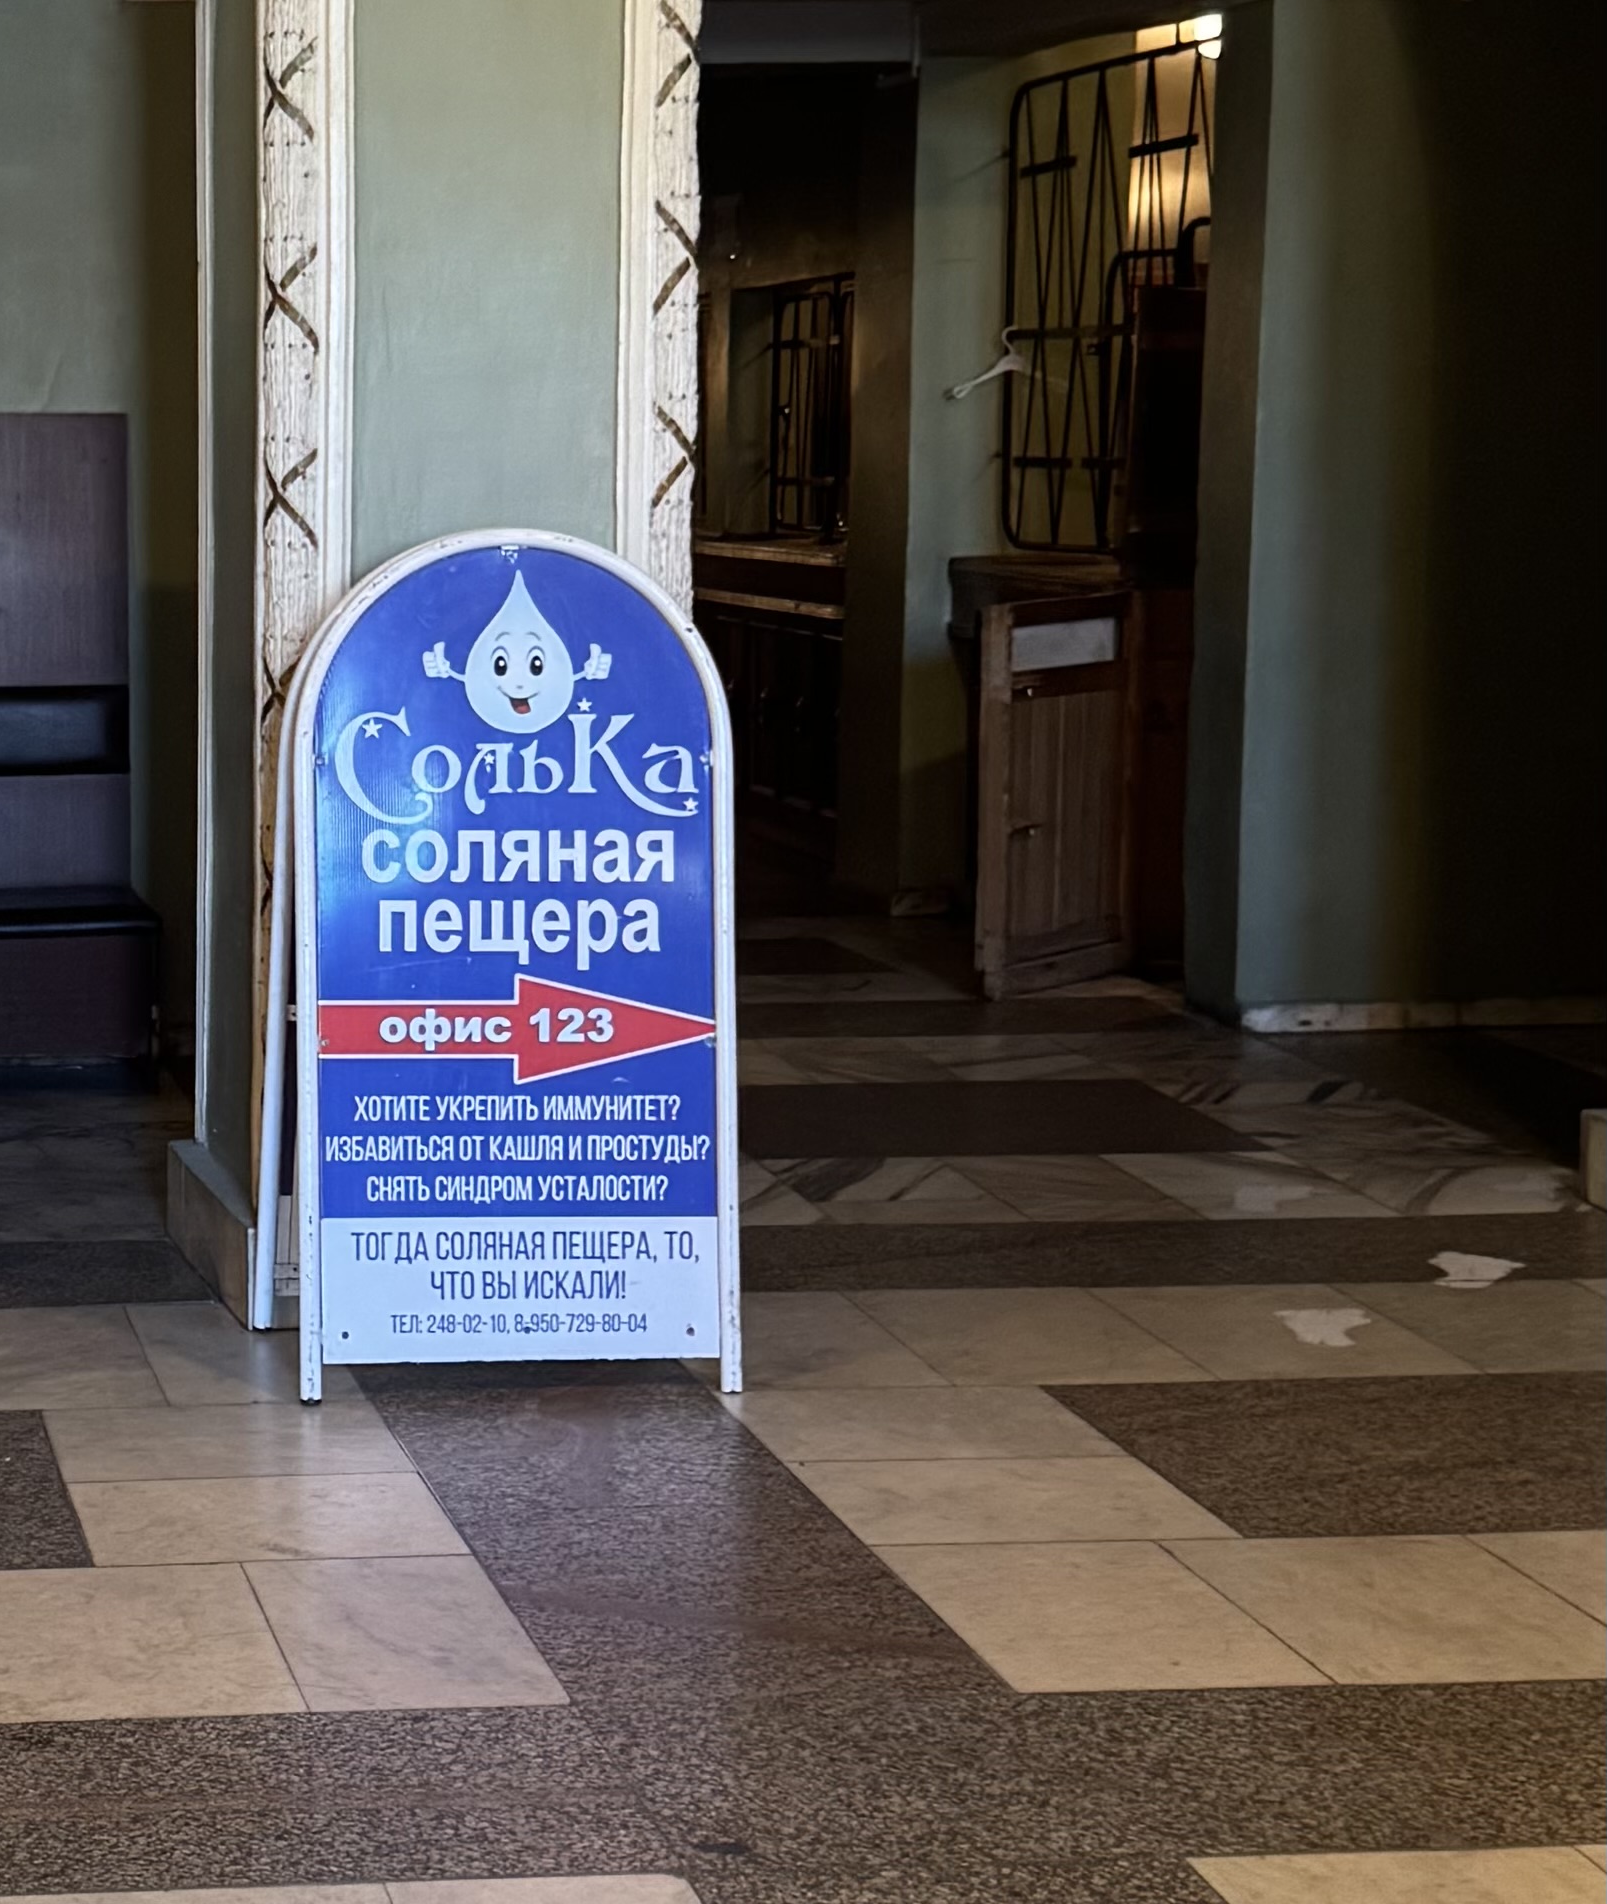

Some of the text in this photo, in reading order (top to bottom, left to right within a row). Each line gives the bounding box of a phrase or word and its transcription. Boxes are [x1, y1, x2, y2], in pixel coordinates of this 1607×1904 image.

[361, 828, 675, 884] соляная
[378, 898, 662, 972] пещера
[378, 1007, 615, 1052] офис 123
[353, 1094, 681, 1122] ХОТИТЕ УКРЕПИТЬ ИММУНИТЕТ?
[324, 1134, 711, 1164] ИЗБАВИТЬСЯ ОТ КАШЛЯ И ПРОСТУДЫ?
[365, 1174, 669, 1205] СНЯТЬ СИНДРОМ УСТАЛОСТИ?
[350, 1230, 700, 1265] ТОГДА СОЛЯНАЯ ПЕЩЕРА, ТО,
[430, 1270, 627, 1301] ЧТО ВЫ ИСКАЛИ!
[390, 1312, 648, 1336] ТЕЛ: 248-02-10, 8-950-729-80-04
